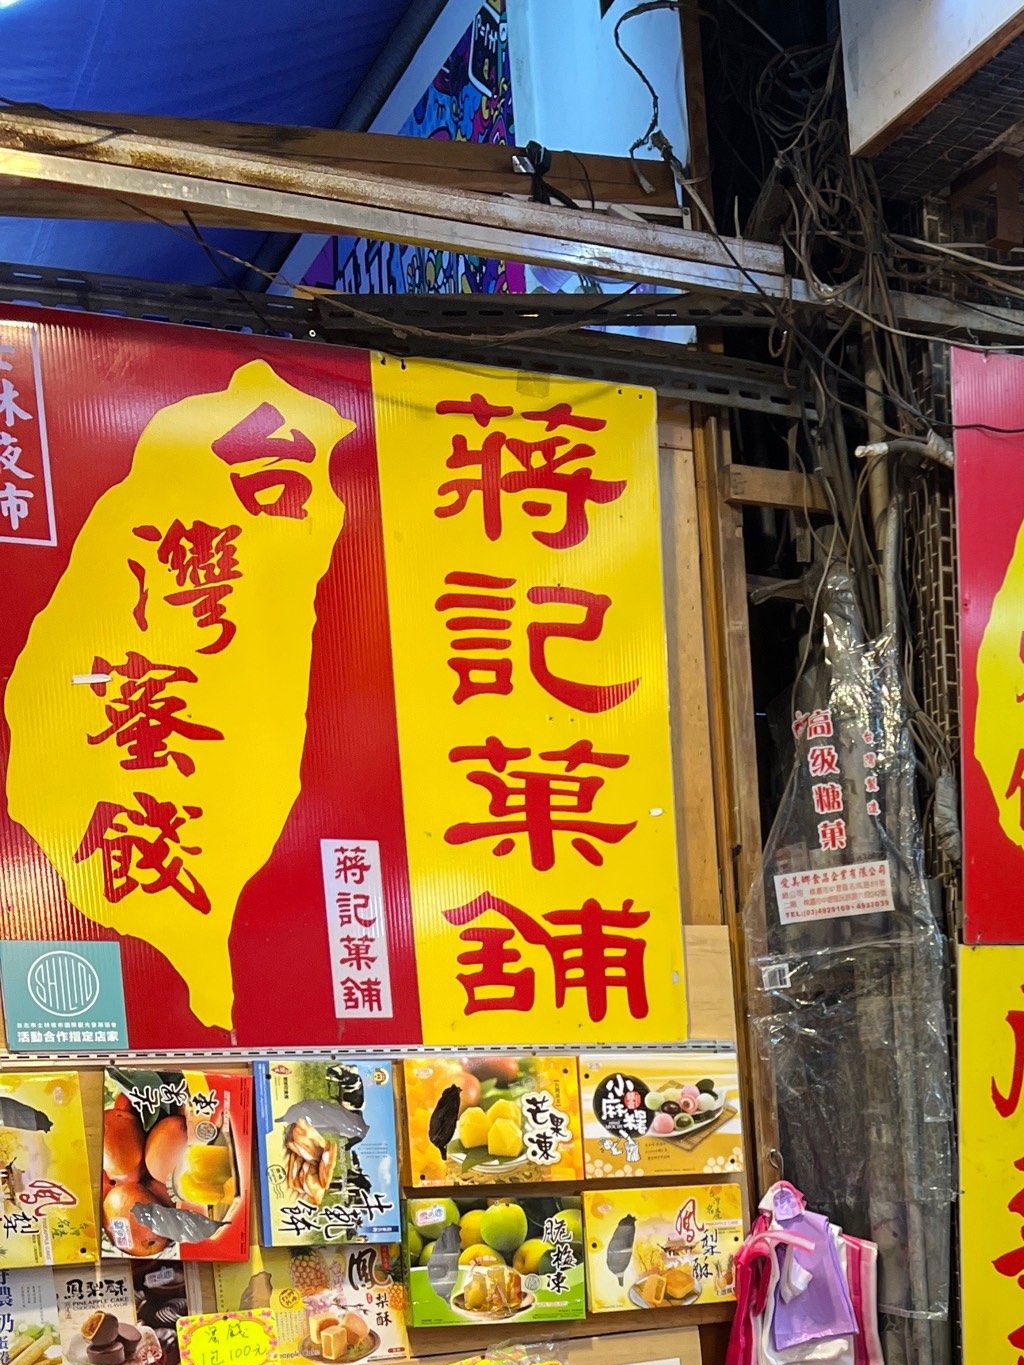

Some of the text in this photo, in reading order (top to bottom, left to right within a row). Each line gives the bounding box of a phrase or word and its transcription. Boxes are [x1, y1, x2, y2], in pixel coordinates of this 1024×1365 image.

[73, 402, 316, 915] 台灣蜜餞
[435, 393, 651, 1022] 蔣記菓舖
[17, 1031, 119, 1042] 活動合作指定店家
[333, 847, 384, 1012] 蔣記菓舖
